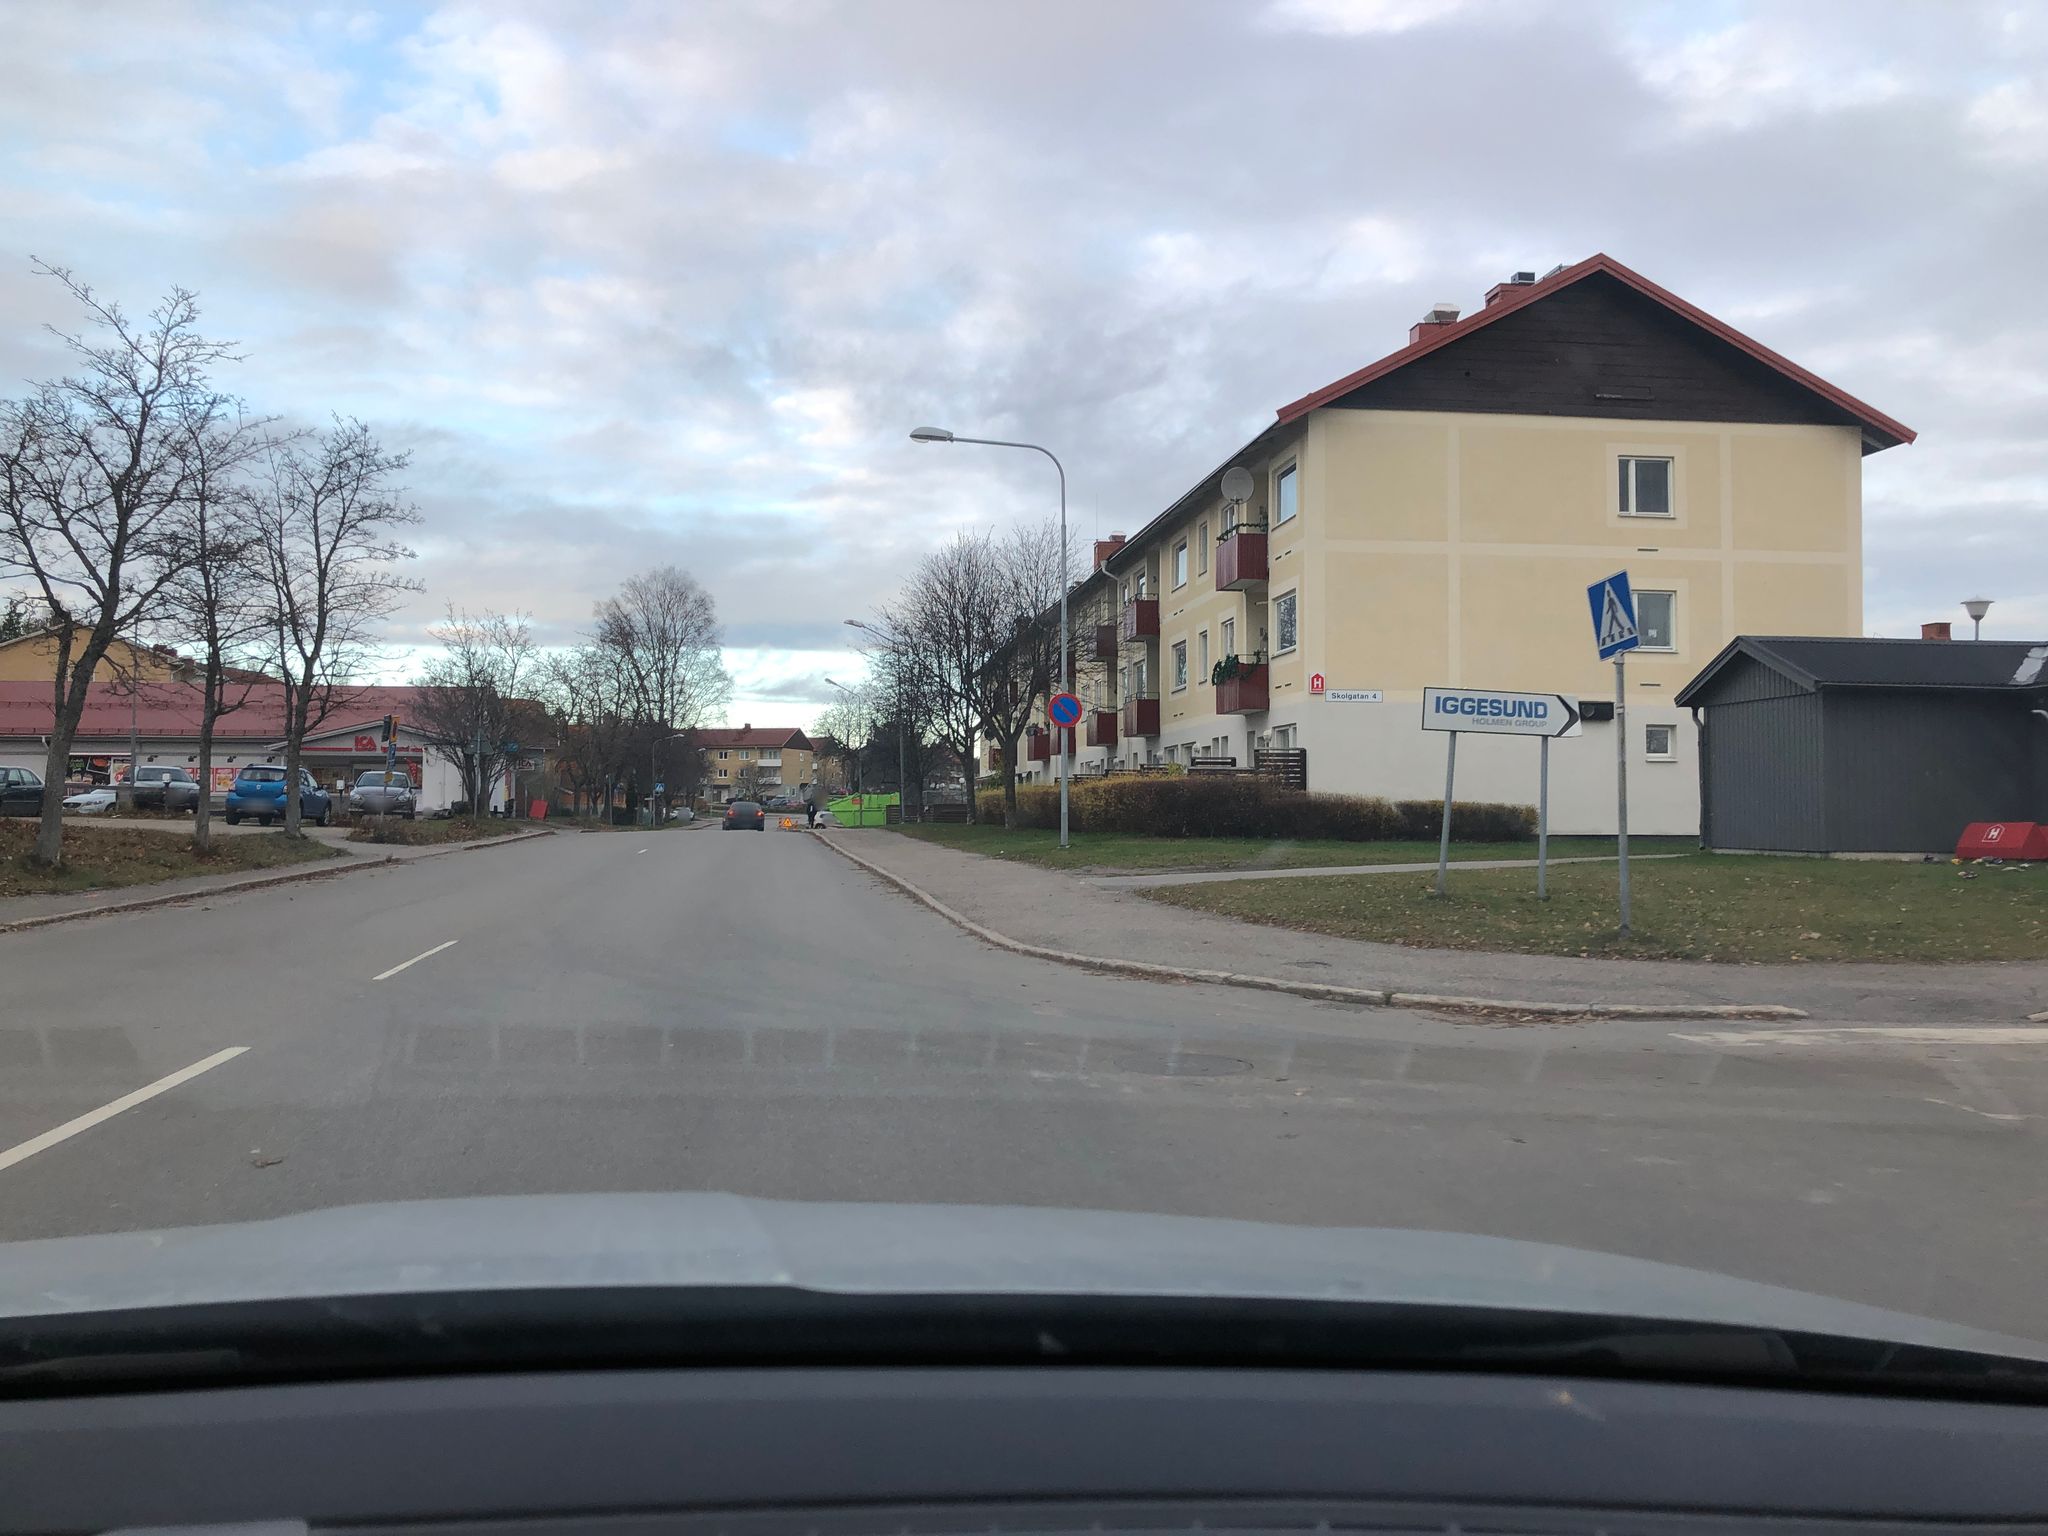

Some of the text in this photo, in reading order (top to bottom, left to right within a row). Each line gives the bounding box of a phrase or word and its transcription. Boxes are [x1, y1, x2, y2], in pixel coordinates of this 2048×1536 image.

[1331, 692, 1369, 701] Skolgatan
[1434, 695, 1548, 719] IGGESUND
[1471, 717, 1547, 728] HOLMEN GROUP
[354, 735, 377, 752] ICA
